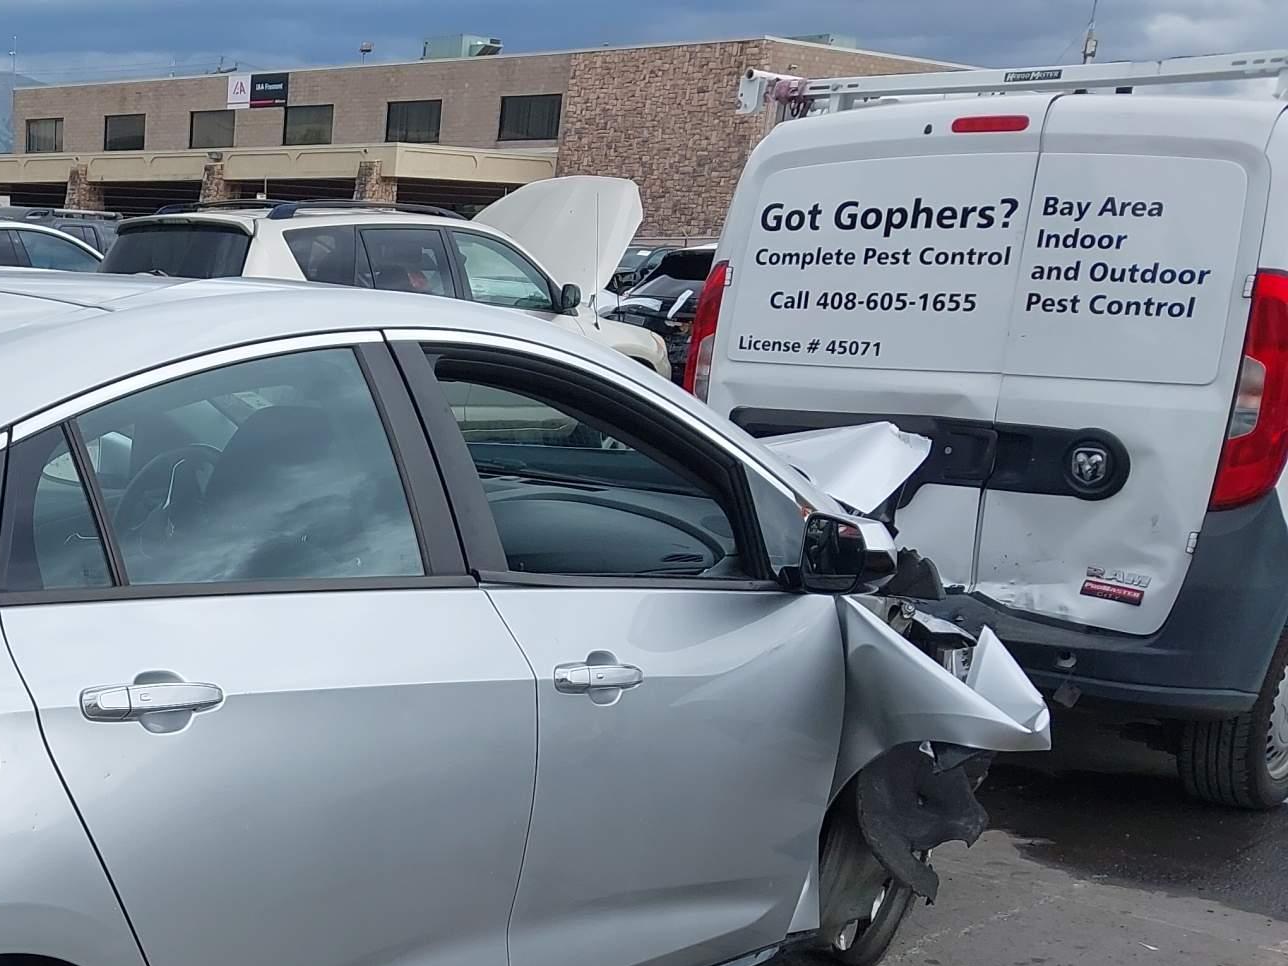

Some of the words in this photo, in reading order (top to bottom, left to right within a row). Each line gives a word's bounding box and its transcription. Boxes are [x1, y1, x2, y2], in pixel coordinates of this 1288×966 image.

[761, 202, 822, 232] Got
[834, 198, 1019, 238] Gophers?
[1043, 196, 1092, 222] Bay
[1098, 196, 1164, 217] Area
[1036, 228, 1128, 250] Indoor
[755, 248, 856, 270] Complete
[863, 247, 911, 266] Pest
[919, 246, 1012, 266] Control
[1031, 260, 1081, 281] and
[1089, 262, 1212, 285] Outdoor
[770, 291, 810, 310] Call
[816, 291, 977, 312] 408-605-1655
[1025, 292, 1081, 314] Pest
[1089, 294, 1197, 318] Control
[738, 335, 801, 354] License
[806, 338, 822, 354] #
[825, 339, 882, 357] 45071
[1086, 566, 1151, 588] RAM
